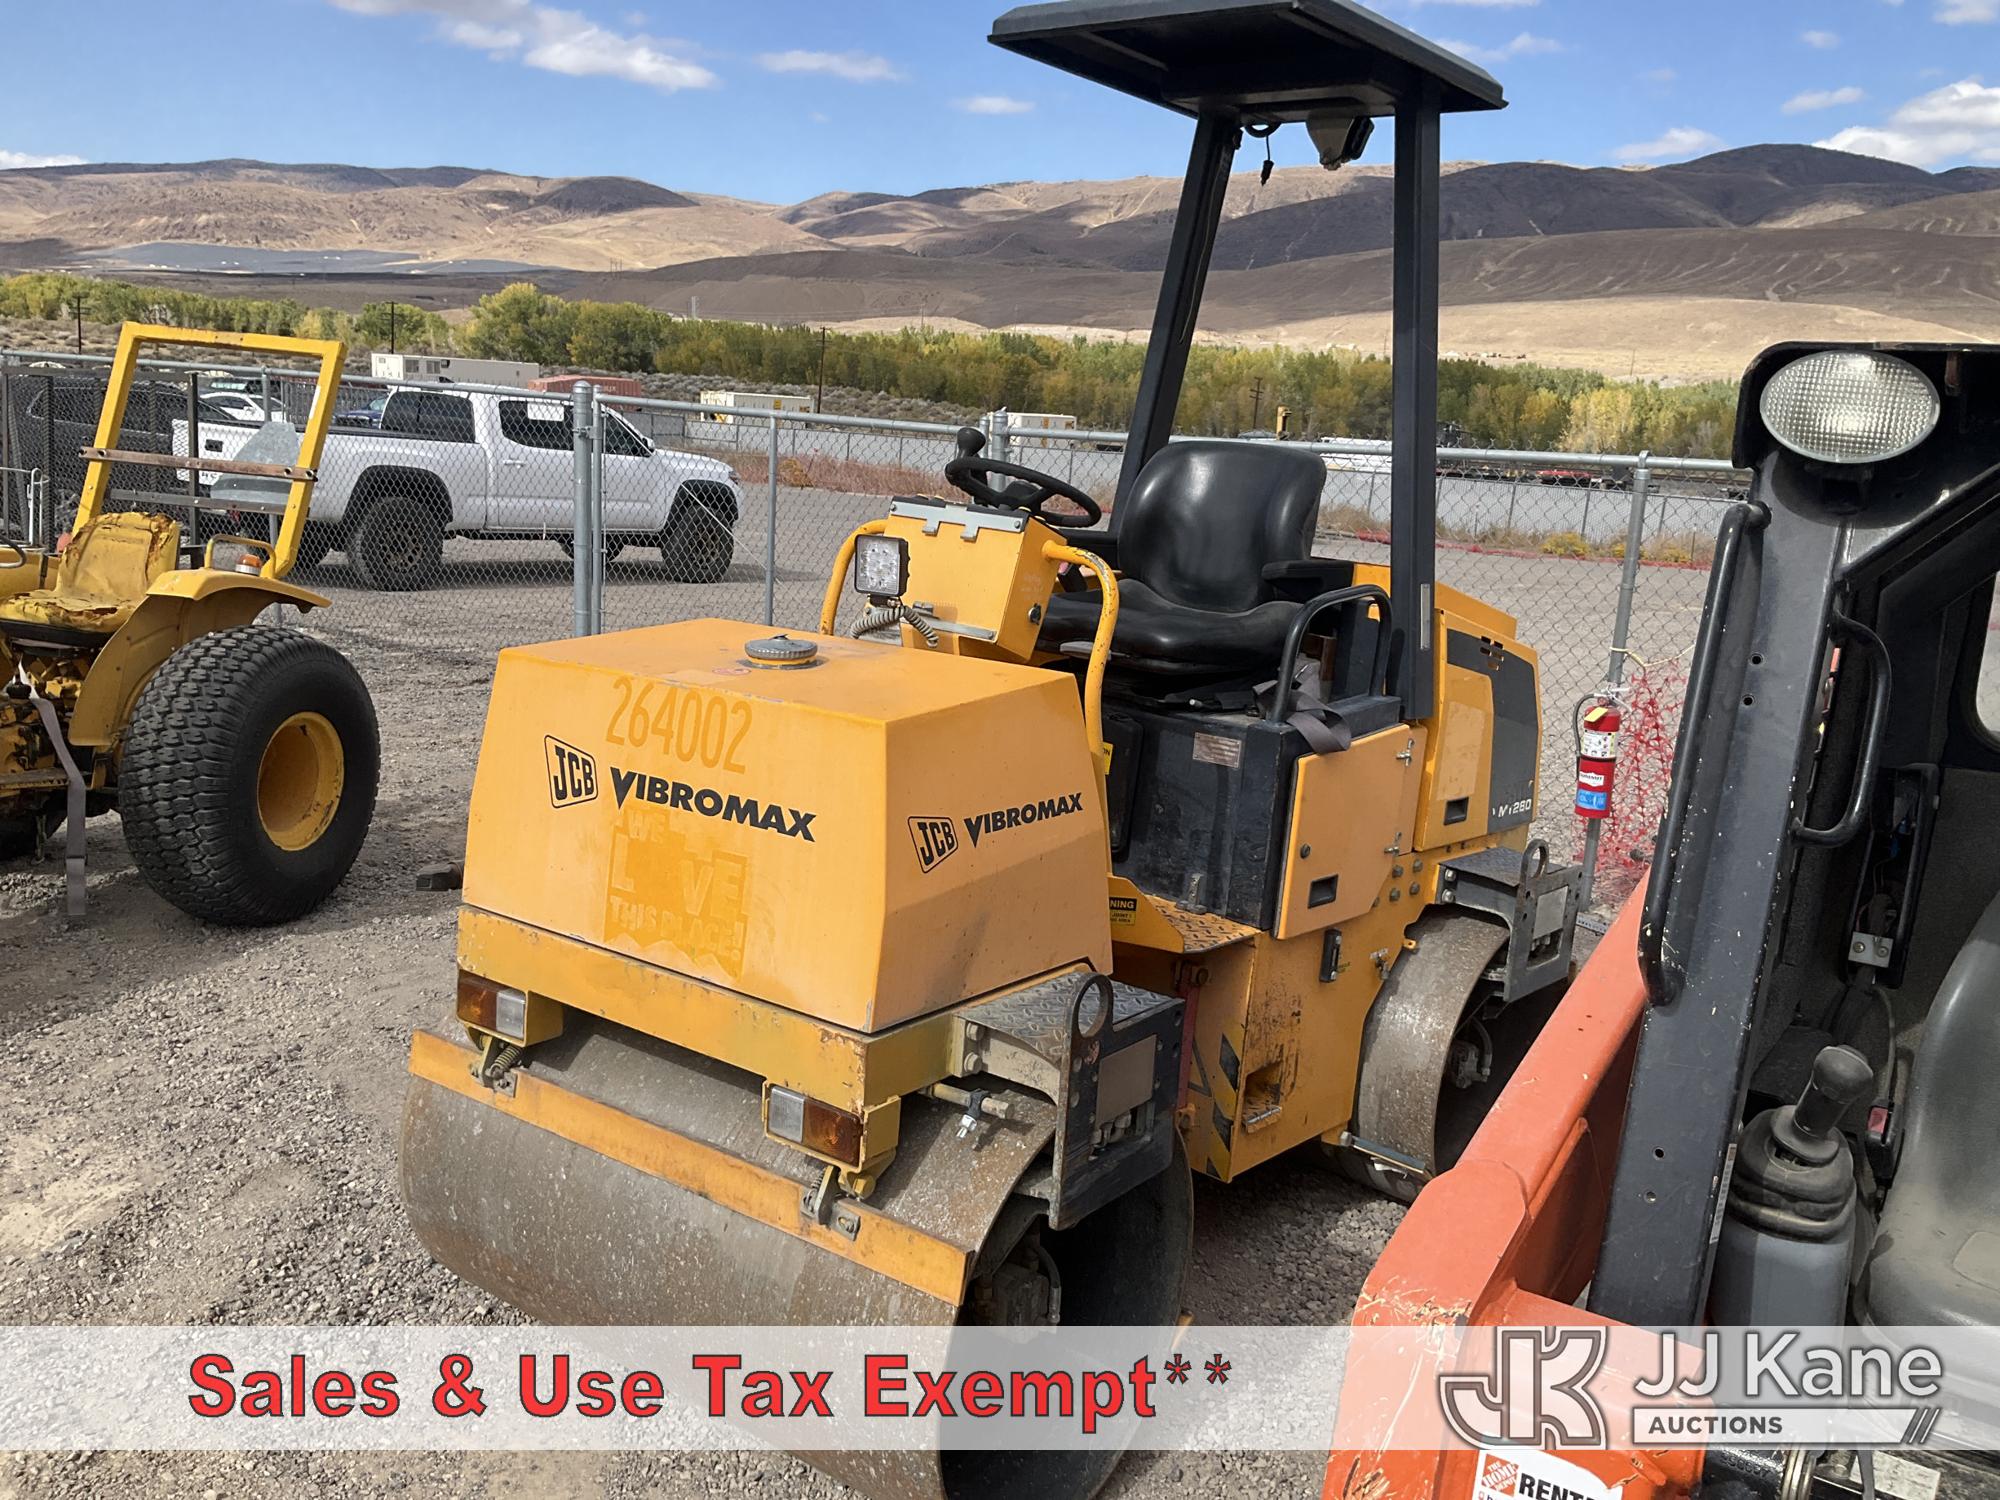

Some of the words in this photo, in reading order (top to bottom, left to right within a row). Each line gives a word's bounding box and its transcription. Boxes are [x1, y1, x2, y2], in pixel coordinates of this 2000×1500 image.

[606, 676, 752, 774] 264002
[553, 745, 595, 801] JCB
[610, 766, 817, 842] VIBROMAX
[917, 822, 956, 866] JCB
[964, 792, 1084, 848] VIBROMAX
[1518, 1472, 1595, 1500] RENT
